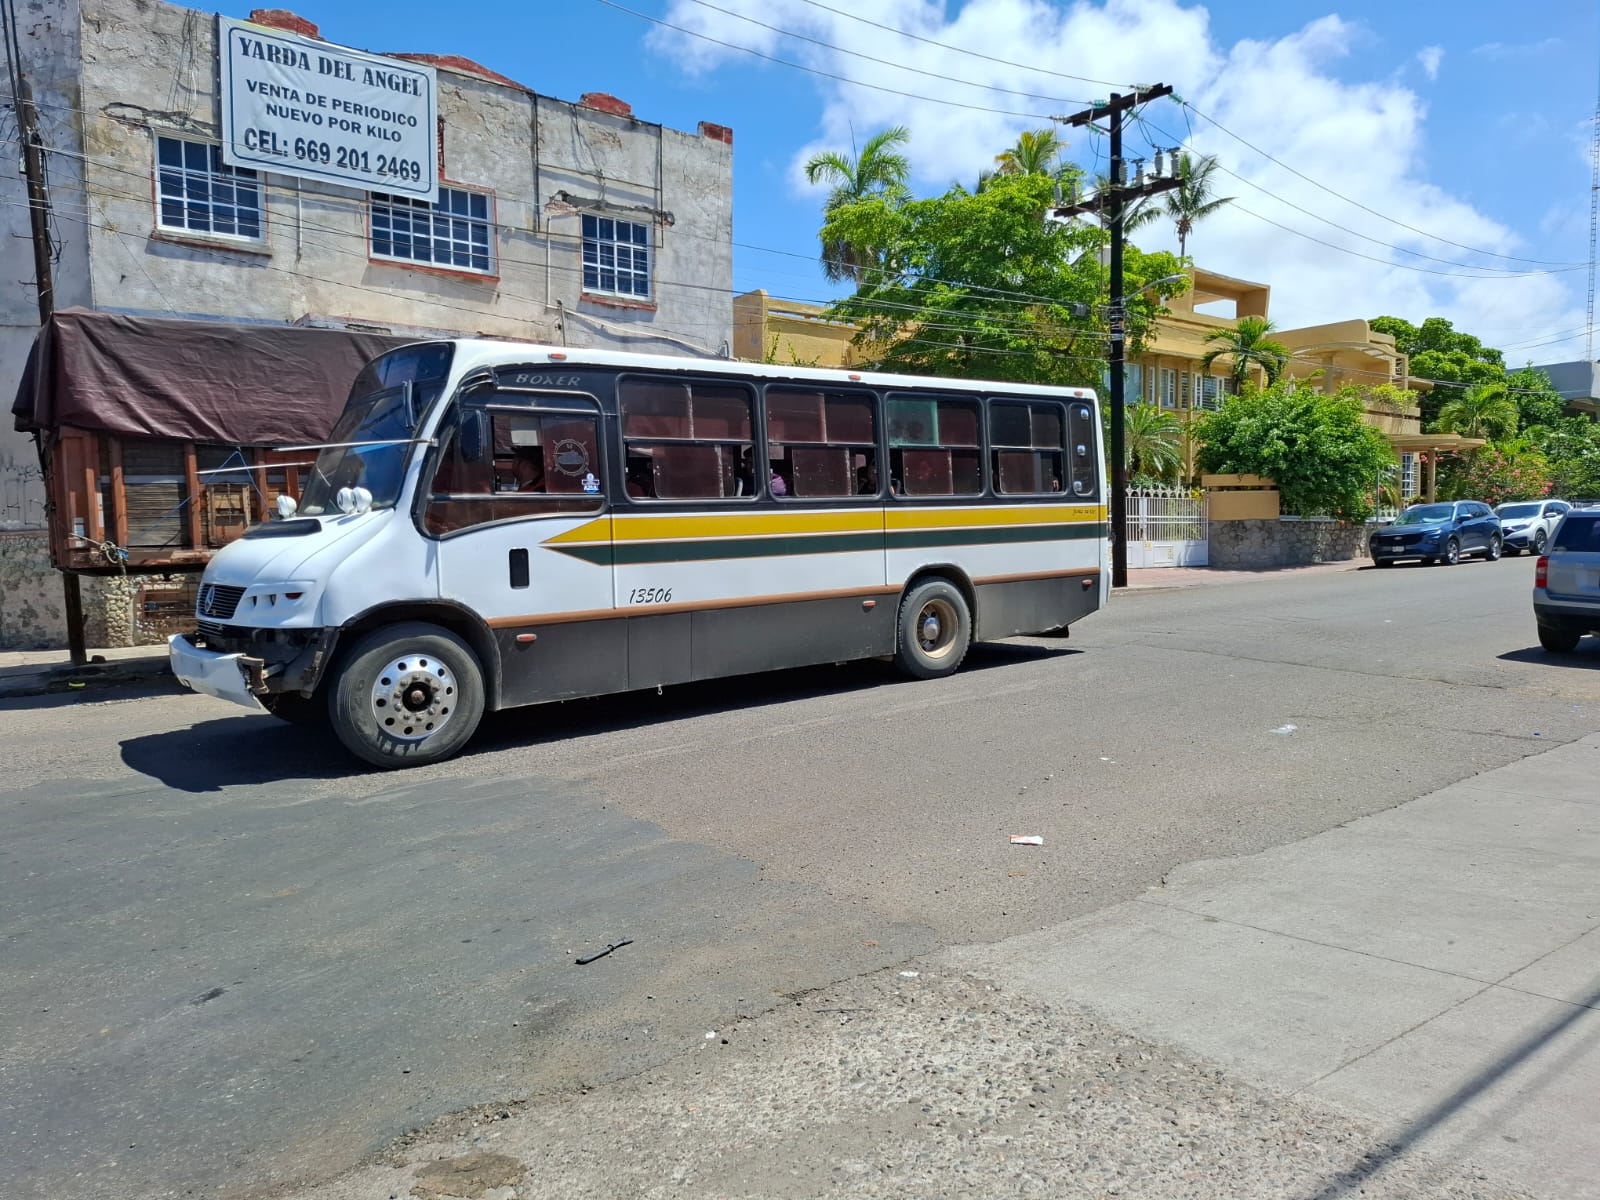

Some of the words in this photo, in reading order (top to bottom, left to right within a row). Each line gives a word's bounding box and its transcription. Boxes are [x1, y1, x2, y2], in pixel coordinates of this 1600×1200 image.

[239, 37, 311, 72] YARDA
[318, 56, 356, 82] DEL
[362, 67, 422, 97] ANGEL
[246, 79, 301, 103] VENTA
[306, 93, 327, 108] DE
[332, 98, 418, 128] PERIODICO
[266, 104, 324, 126] NUEVO
[328, 117, 362, 135] POR
[367, 124, 402, 143] KILO
[244, 128, 289, 158] CEL:
[294, 137, 331, 164] 669
[336, 146, 372, 174] 201
[376, 154, 421, 183] 2469
[515, 373, 581, 387] BOXER
[629, 587, 673, 604] 13506
